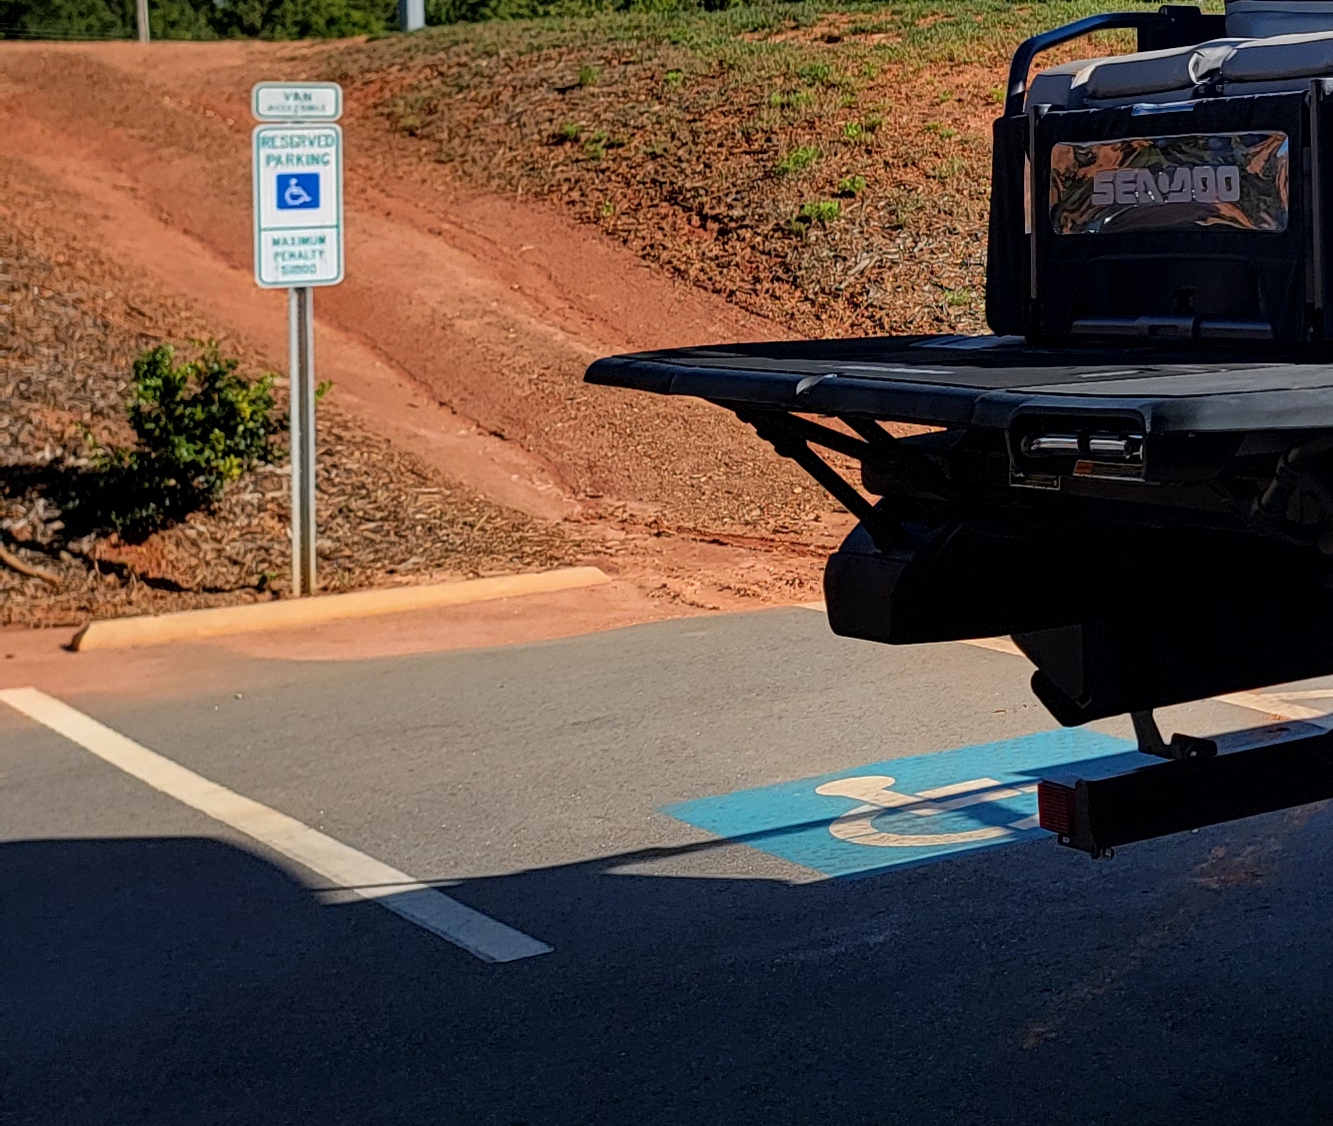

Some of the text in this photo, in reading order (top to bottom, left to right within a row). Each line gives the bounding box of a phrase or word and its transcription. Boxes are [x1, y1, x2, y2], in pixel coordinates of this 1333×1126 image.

[283, 91, 312, 102] VAN
[261, 134, 335, 149] RESERVED
[265, 153, 330, 167] PARKING
[272, 236, 326, 246] MAXIMUM
[274, 249, 325, 262] PENALTY
